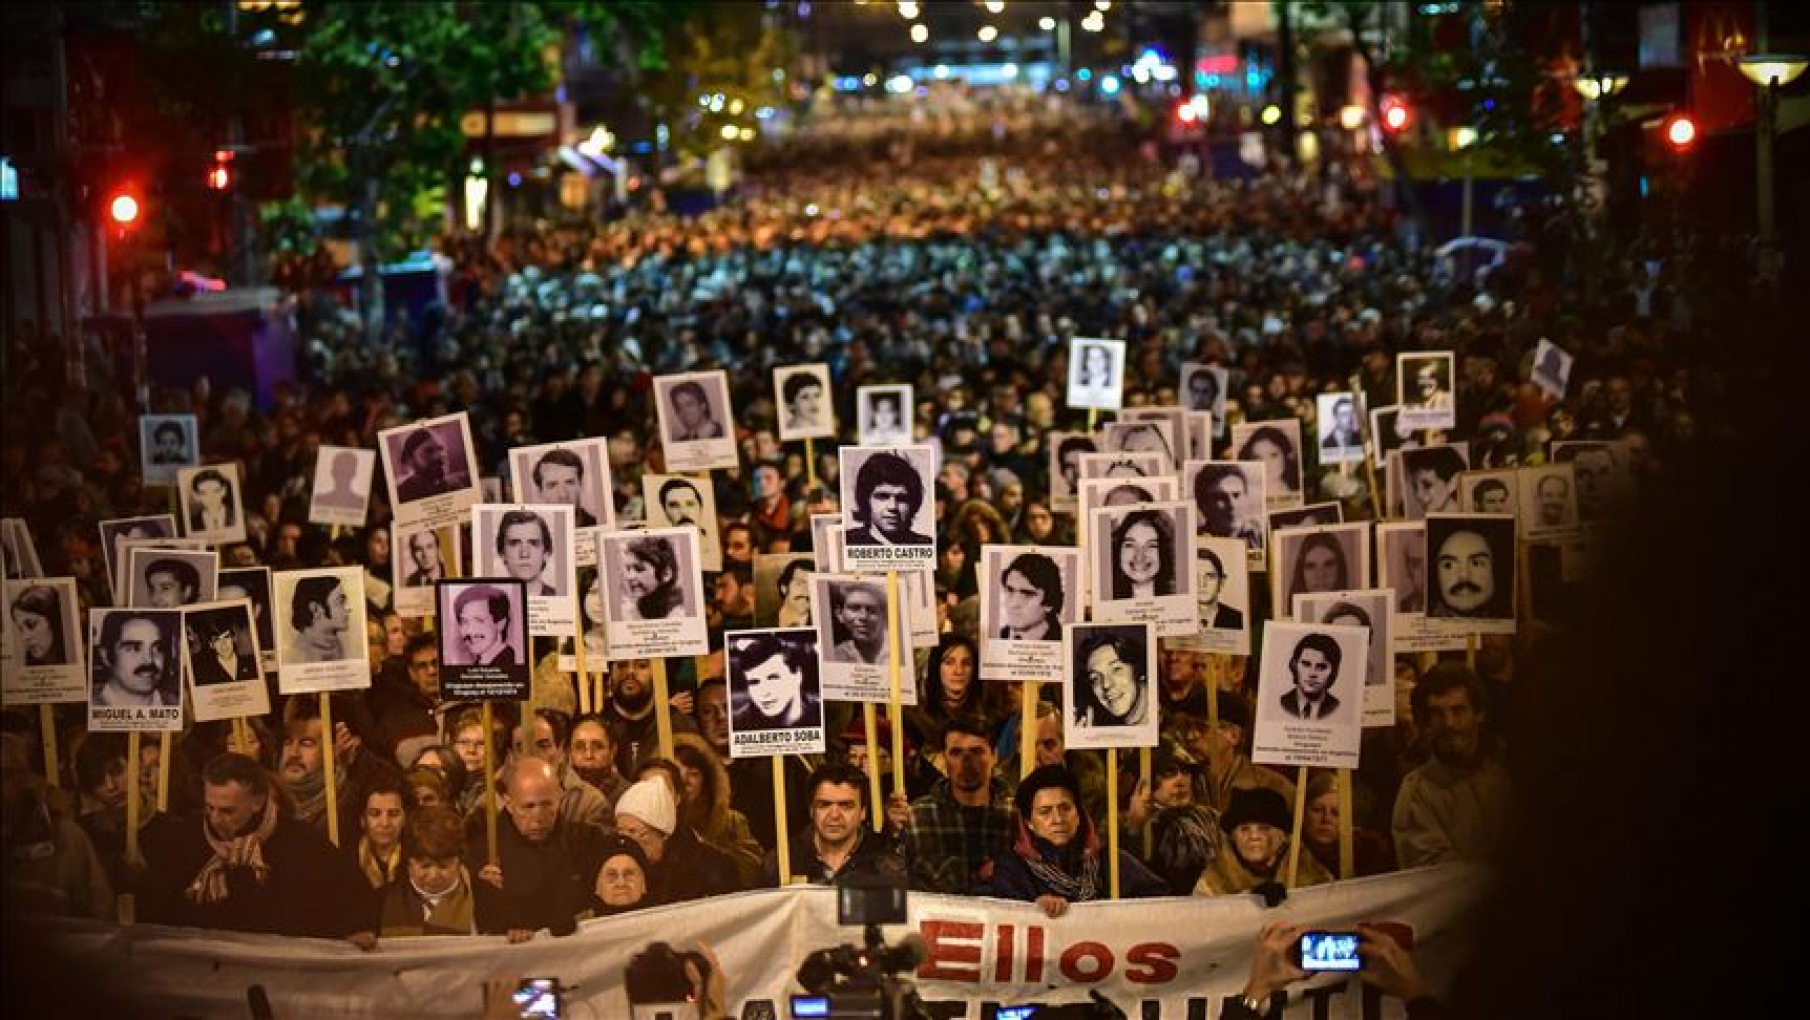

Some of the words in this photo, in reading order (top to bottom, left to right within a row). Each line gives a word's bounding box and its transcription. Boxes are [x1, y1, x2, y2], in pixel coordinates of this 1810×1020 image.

[847, 547, 893, 559] ROBERTO
[894, 547, 933, 559] CASTRO
[92, 707, 132, 720] MIGUEL
[148, 707, 179, 719] MATO
[734, 731, 792, 746] ADALBERTO
[793, 729, 820, 742] SOBA
[917, 918, 1182, 985] Ellos
